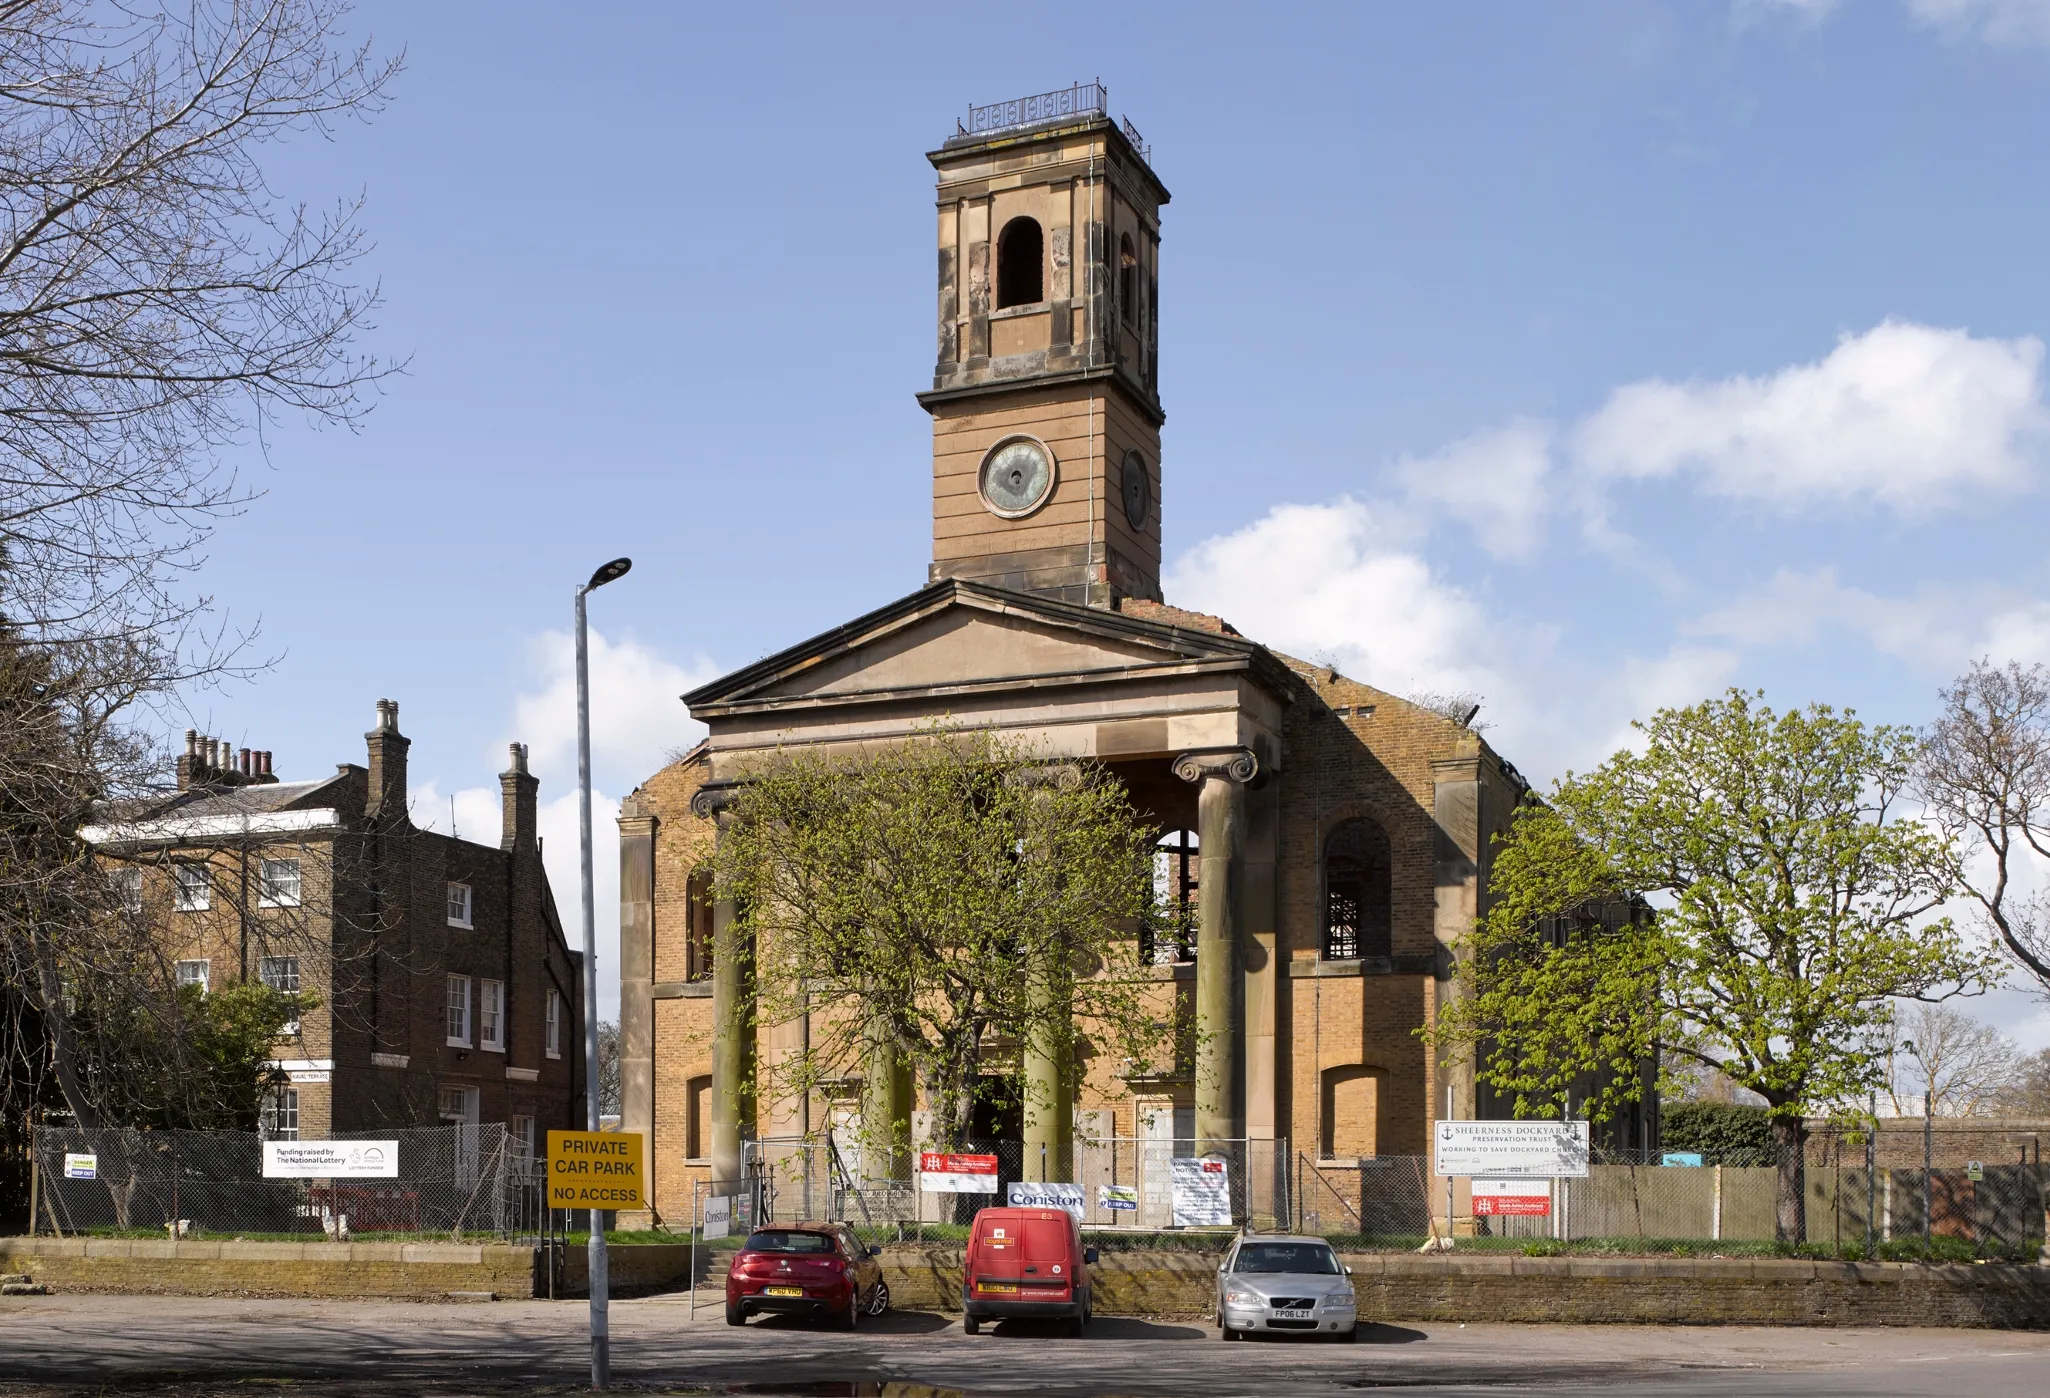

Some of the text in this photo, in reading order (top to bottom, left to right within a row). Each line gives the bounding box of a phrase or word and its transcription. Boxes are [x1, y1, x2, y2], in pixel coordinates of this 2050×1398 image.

[1455, 1127, 1569, 1135] SHEERNESS DOCKYARD
[277, 1148, 303, 1156] Funding
[326, 1148, 335, 1157] by
[563, 1140, 628, 1155] PRIVATE
[320, 1157, 346, 1165] Lottery
[555, 1160, 635, 1176] CAR PARK
[554, 1187, 637, 1202] NO ACCESS
[1009, 1192, 1083, 1206] Coniston
[705, 1210, 729, 1223] Coniston
[1275, 1310, 1310, 1318] FP06 LZT
